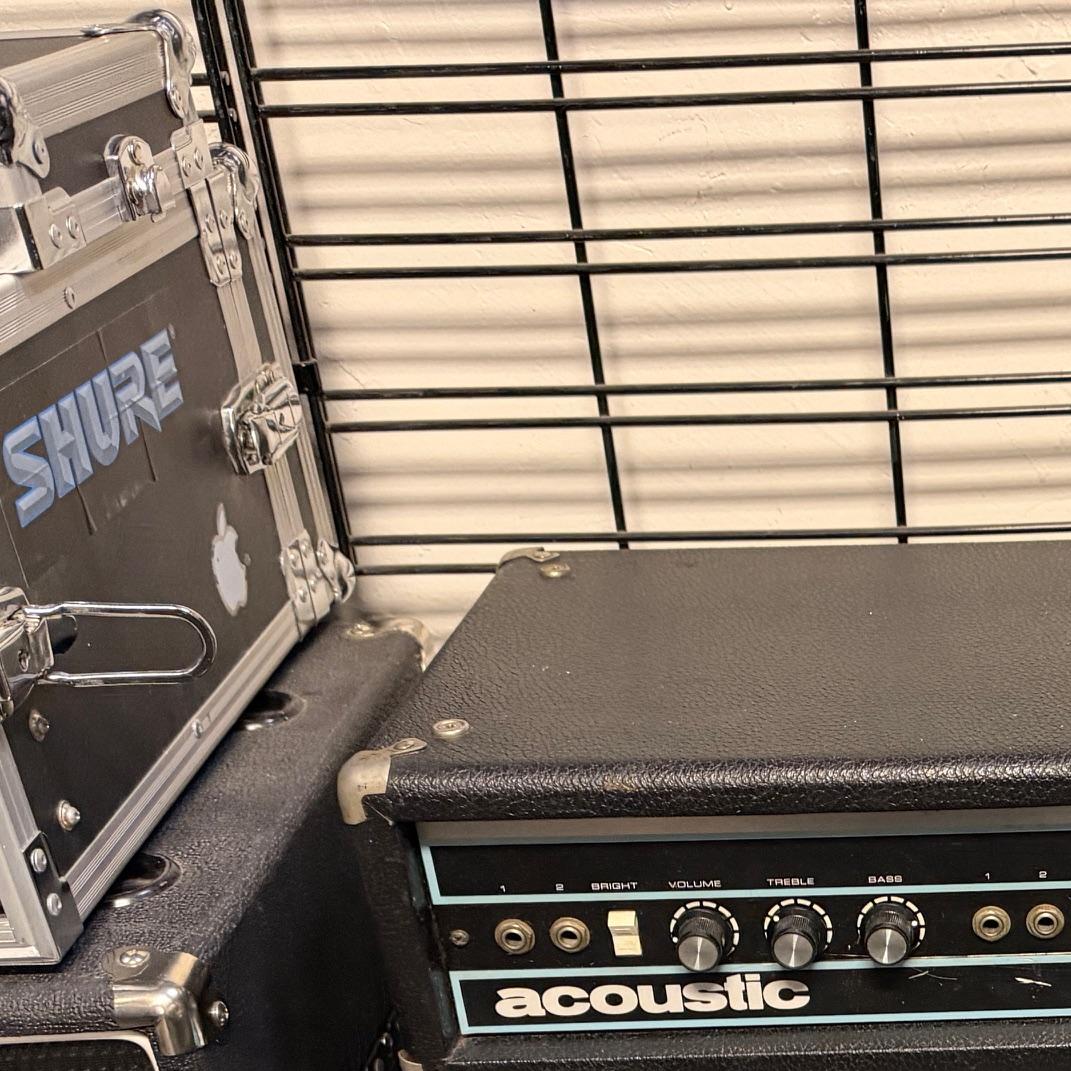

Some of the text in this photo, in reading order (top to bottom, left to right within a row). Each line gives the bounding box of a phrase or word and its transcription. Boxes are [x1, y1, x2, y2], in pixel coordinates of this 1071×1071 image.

[3, 328, 183, 528] SHURE
[668, 879, 722, 889] VOLUME
[766, 877, 815, 887] TREBLE
[868, 874, 903, 884] BASS
[591, 881, 638, 891] BRIGHT
[494, 973, 811, 1018] acoustic
